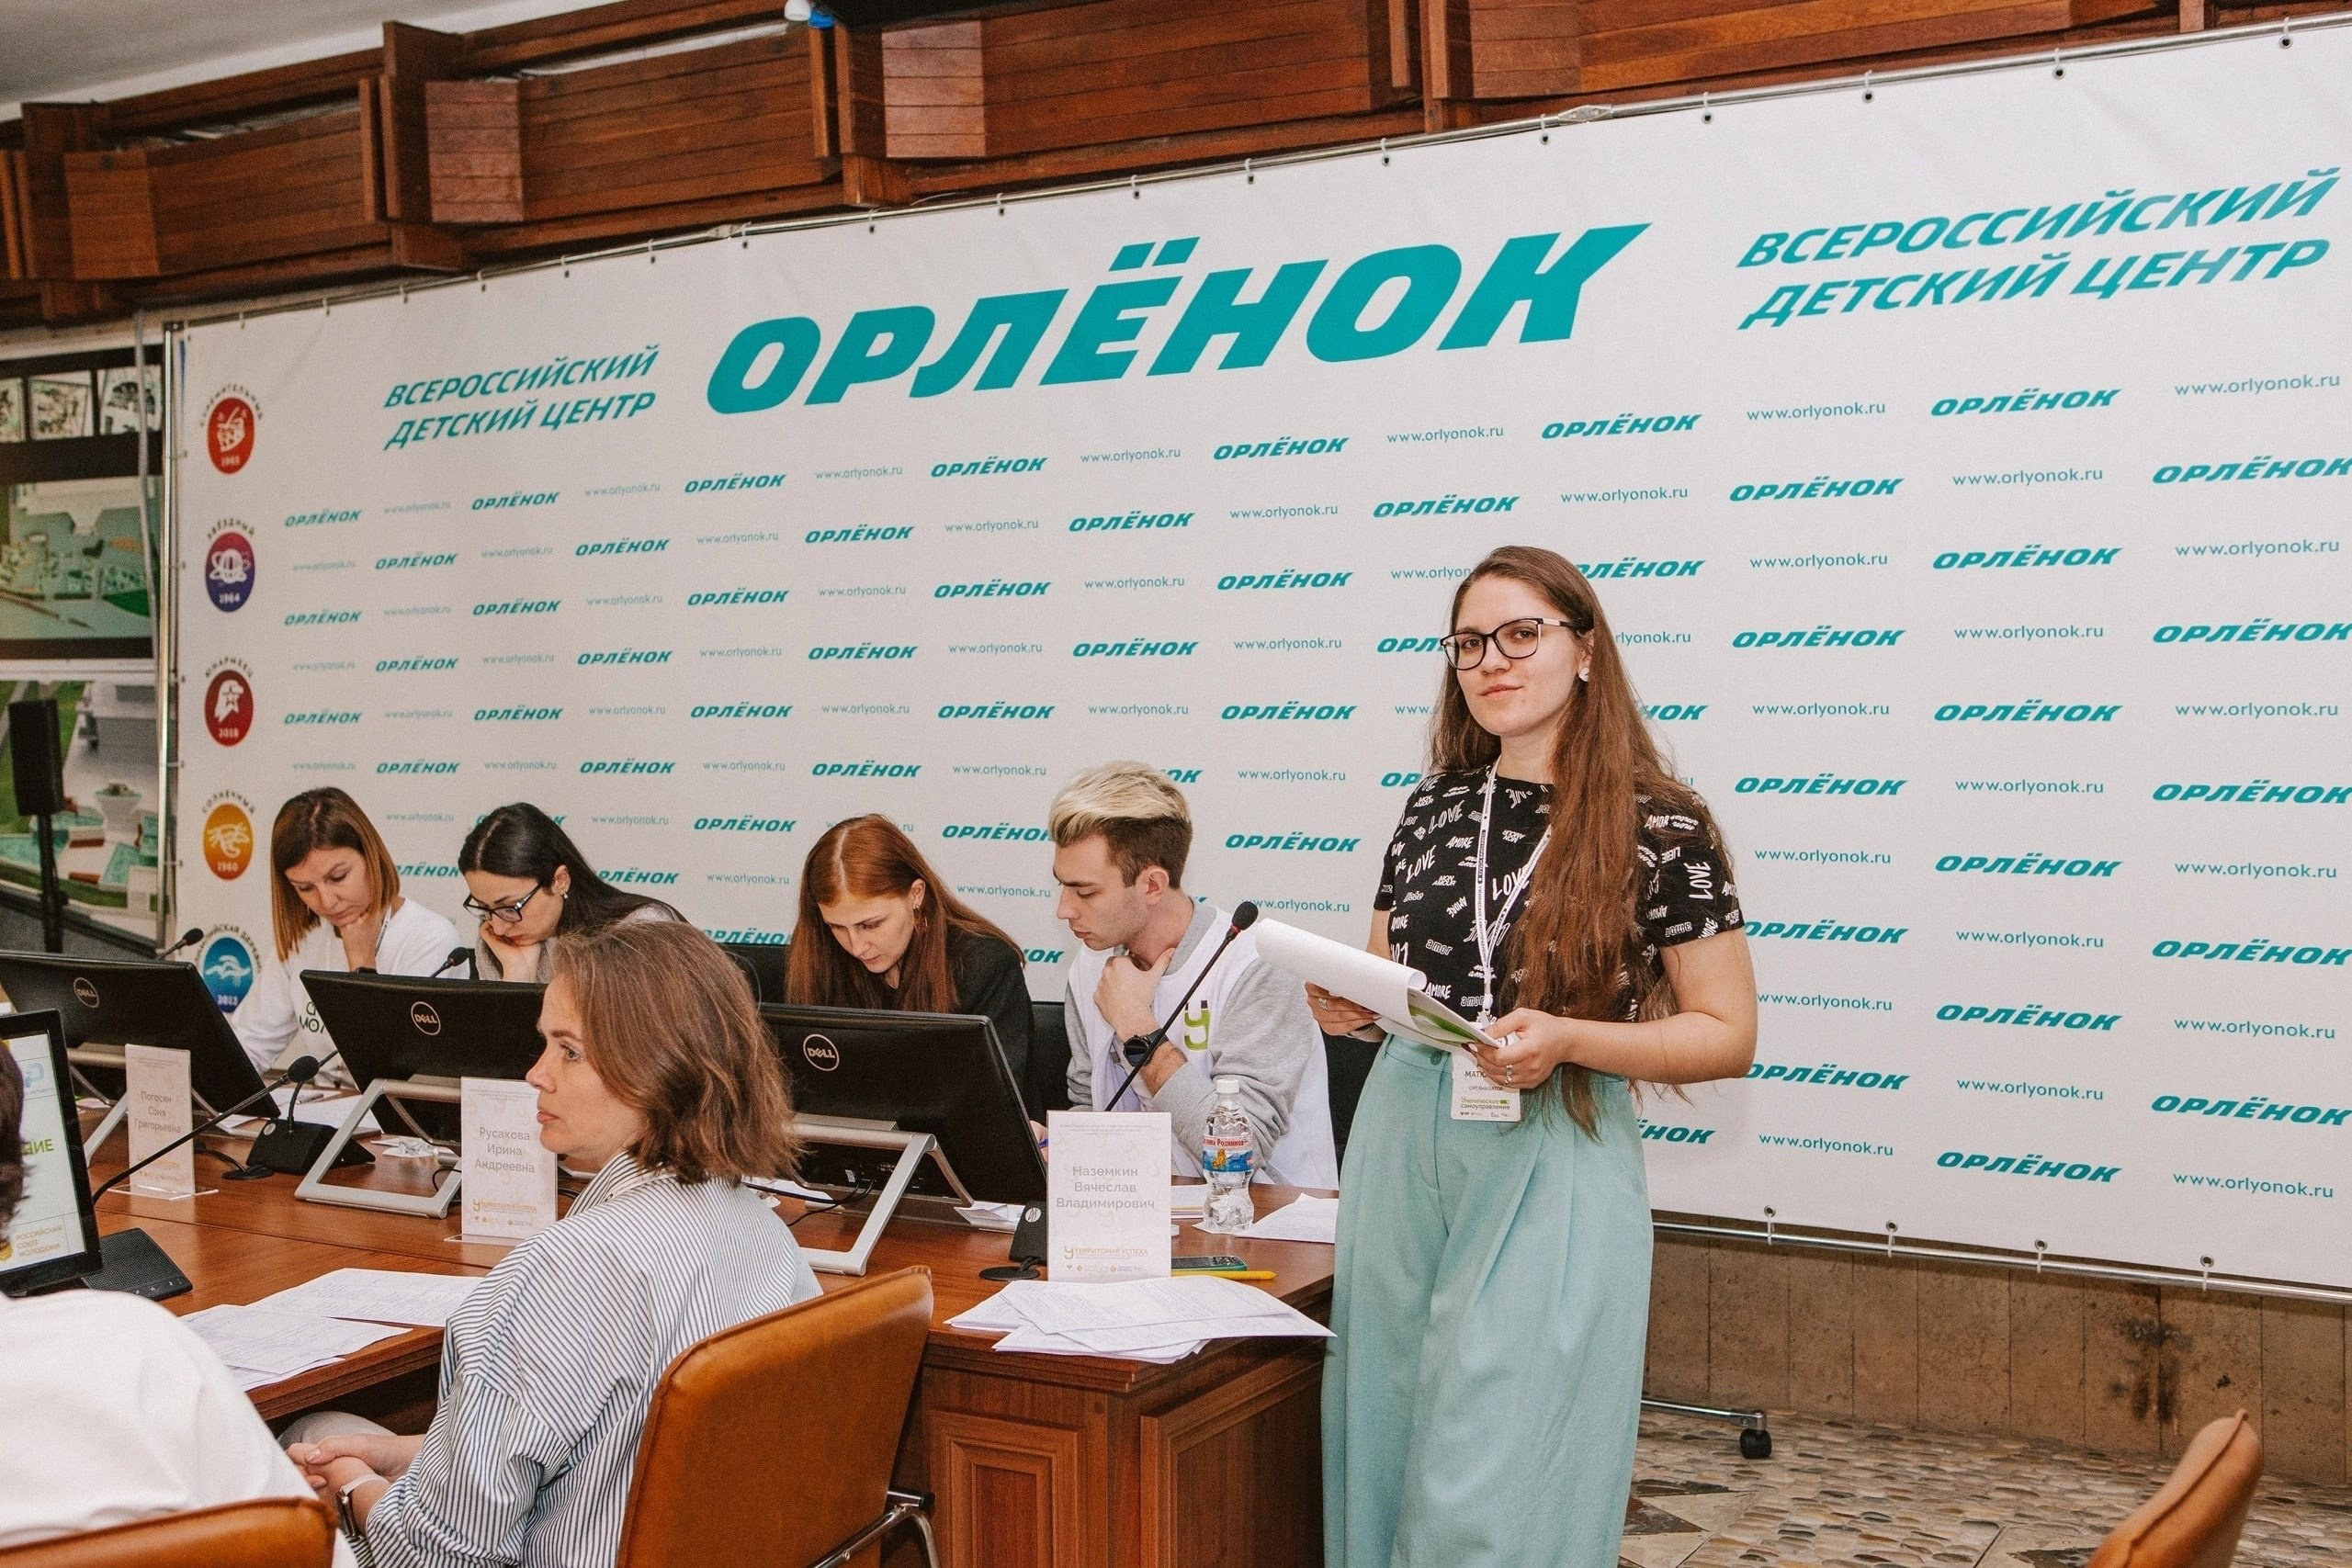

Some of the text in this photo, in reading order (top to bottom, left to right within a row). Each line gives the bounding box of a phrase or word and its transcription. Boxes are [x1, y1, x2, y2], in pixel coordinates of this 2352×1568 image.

[1736, 166, 2342, 268] ВСЕРОССИЙСКИЙ
[1736, 239, 2332, 331] ДЕТСКИЙ ЦЕНТР
[706, 222, 1654, 415] ОРЛЁНОК
[383, 343, 661, 410] ВСЕРОССИЙСКИЙ
[2174, 374, 2341, 396] www.orlyonok.ru
[1747, 401, 1886, 421] www.orlyonok.ru
[1929, 387, 2123, 419] ОРЛЁНОК
[382, 390, 658, 451] ДЕТСКИЙ ЦЕНТР
[1541, 412, 1702, 441] ОРЛЁНОК
[1386, 426, 1504, 443] www.orlyonok.ru
[1080, 447, 1181, 463] www.orlyonok.ru
[1212, 435, 1351, 462] ОРЛЁНОК
[815, 466, 902, 479] www.orlyonok.ru
[930, 456, 1049, 479] ОРЛЁНОК
[684, 472, 787, 495] ОРЛЁНОК
[1952, 468, 2103, 486] www.orlyonok.ru
[585, 483, 661, 496] www.orlyonok.ru
[1560, 486, 1689, 503] www.orlyonok.ru
[1728, 475, 1905, 503] ОРЛЁНОК
[470, 491, 560, 513] ОРЛЁНОК
[1372, 493, 1521, 520] ОРЛЁНОК
[284, 508, 363, 528] ОРЛЁНОК
[1229, 504, 1338, 520] www.orlyonok.ru
[944, 519, 1039, 533] www.orlyonok.ru
[1067, 510, 1195, 534] ОРЛЁНОК
[696, 532, 778, 544] www.orlyonok.ru
[803, 524, 915, 545] ОРЛЁНОК
[573, 537, 671, 558] ОРЛЁНОК
[2175, 539, 2340, 558] www.orlyonok.ru
[374, 551, 458, 571] ОРЛЁНОК
[1749, 552, 1888, 570] www.orlyonok.ru
[1931, 544, 2123, 571] ОРЛЁНОК
[1216, 569, 1354, 592] ОРЛЁНОК
[1390, 567, 1471, 581] www.orlyon
[819, 585, 906, 597] www.orlyonok.ru
[933, 578, 1053, 600] ОРЛЁНОК
[1084, 576, 1185, 591] www.orlyonok.ru
[587, 594, 662, 605] www.orlyonok.ru
[686, 587, 791, 607] ОРЛЁНОК
[471, 598, 562, 617] ОРЛЁНОК
[283, 608, 363, 626] ОРЛЁНОК
[1730, 624, 1906, 649] ОРЛЁНОК
[1953, 625, 2104, 642] www.orlyonok.ru
[699, 647, 782, 658] www.orlyonok.ru
[808, 641, 919, 661] ОРЛЁНОК
[948, 642, 1043, 656] www.orlyonok.ru
[1071, 637, 1200, 659] ОРЛЁНОК
[1234, 637, 1342, 651] www.orlyonok.ru
[374, 655, 459, 673] ОРЛЁНОК
[576, 648, 673, 667] ОРЛЁНОК
[283, 708, 363, 726] ОРЛЁНОК
[472, 704, 564, 723] ОРЛЁНОК
[589, 705, 665, 715] www.orlyonok.ru
[690, 701, 794, 719] ОРЛЁНОК
[821, 704, 910, 716] www.orlyonok.ru
[936, 700, 1057, 720] ОРЛЁНОК
[1088, 704, 1189, 716] www.orlyonok.ru
[1219, 700, 1358, 721] ОРЛЁНОК
[1752, 702, 1890, 718] www.orlyonok.ru
[1933, 698, 2124, 724] ОРЛЁНОК
[2175, 702, 2339, 719] www.orlyonok.ru
[375, 759, 461, 775] ОРЛЁНОК
[579, 757, 676, 775] ОРЛЁНОК
[703, 761, 786, 772] www.orlyonok.ru
[810, 759, 922, 779] ОРЛЁНОК
[953, 764, 1046, 777] www.orlyonok.ru
[1238, 769, 1346, 783] www.orlyonok.ru
[1734, 773, 1908, 797] ОРЛЁНОК
[1955, 779, 2105, 795] www.orlyonok.ru
[592, 815, 669, 825] www.orlyonok.ru
[693, 814, 797, 833] ОРЛЁНОК
[1428, 800, 1465, 834] LOVE
[1224, 830, 1362, 853] ОРЛЁНОК
[1445, 836, 1475, 850] AMORE
[1406, 844, 1437, 884] LOVE
[1661, 846, 1681, 864] LIEBE
[1754, 849, 1892, 865] www.orlyonok.ru
[1934, 852, 2124, 878] ОРЛЁНОК
[2175, 862, 2337, 879] www.orlyonok.ru
[706, 874, 790, 886] www.orlyonok.ru
[1683, 861, 1714, 900] LOVE
[956, 886, 1051, 897] www.orlyonok.ru
[1425, 939, 1453, 956] amor
[1955, 931, 2104, 949] www.orlyonok.ru
[1424, 982, 1452, 999] AMORE
[1758, 992, 1894, 1010] www.orlyonok.ru
[414, 1013, 437, 1024] DELL
[1935, 1002, 2123, 1032] ОРЛЁНОК
[2174, 1019, 2335, 1040] www.orlyonok.ru
[807, 1047, 836, 1059] DELL
[1956, 1079, 2105, 1101] www.orlyonok.ru
[479, 1126, 530, 1141] Русакова
[487, 1144, 523, 1156] Ирина
[1758, 1134, 1894, 1156] www.orlyonok.ru
[474, 1157, 536, 1173] Андреевна
[1072, 1166, 1139, 1177] Наземкин
[1935, 1150, 2123, 1184] ОРЛЁНОК
[1074, 1181, 1137, 1193] Вячеслав
[2172, 1173, 2335, 1200] www.orlyonok.ru
[1057, 1197, 1155, 1212] Владимирович
